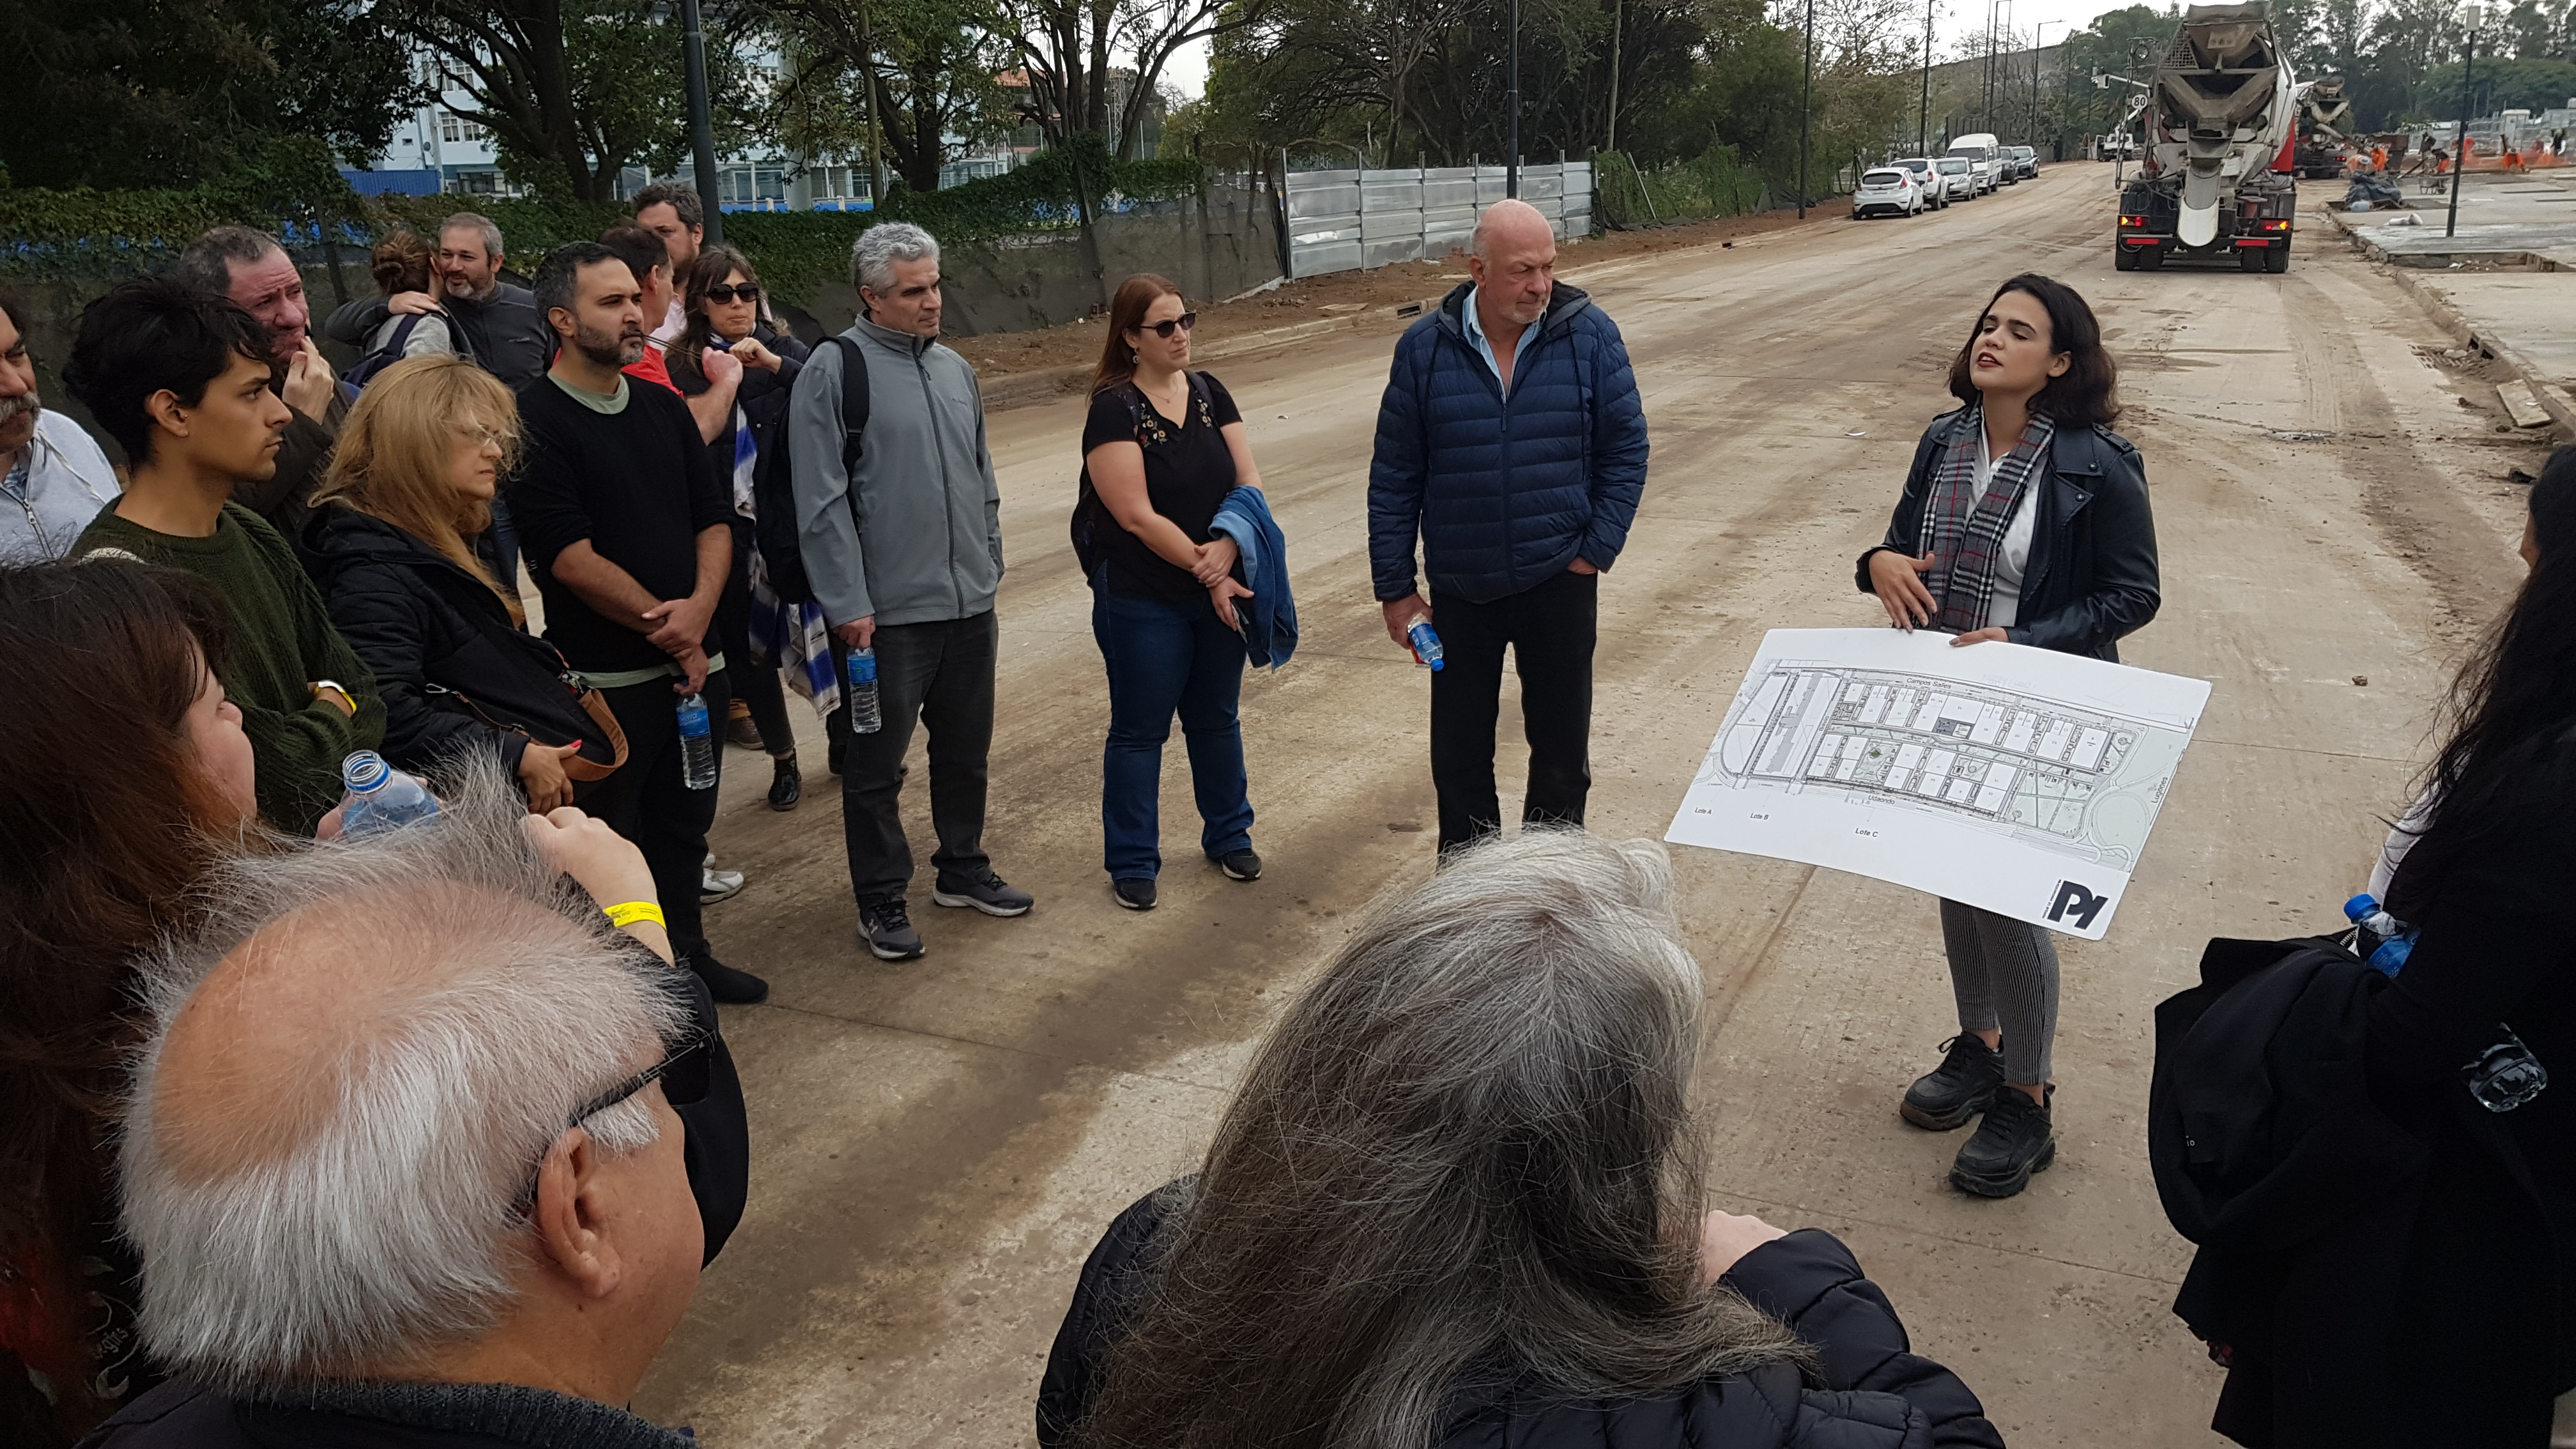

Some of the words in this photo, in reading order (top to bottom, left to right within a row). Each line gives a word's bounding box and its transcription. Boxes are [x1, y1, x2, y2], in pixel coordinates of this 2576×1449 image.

[2134, 96, 2146, 106] 80
[2150, 777, 2168, 804] Lugones
[1868, 795, 1896, 805] Udaondo
[1855, 827, 1871, 836] Lote
